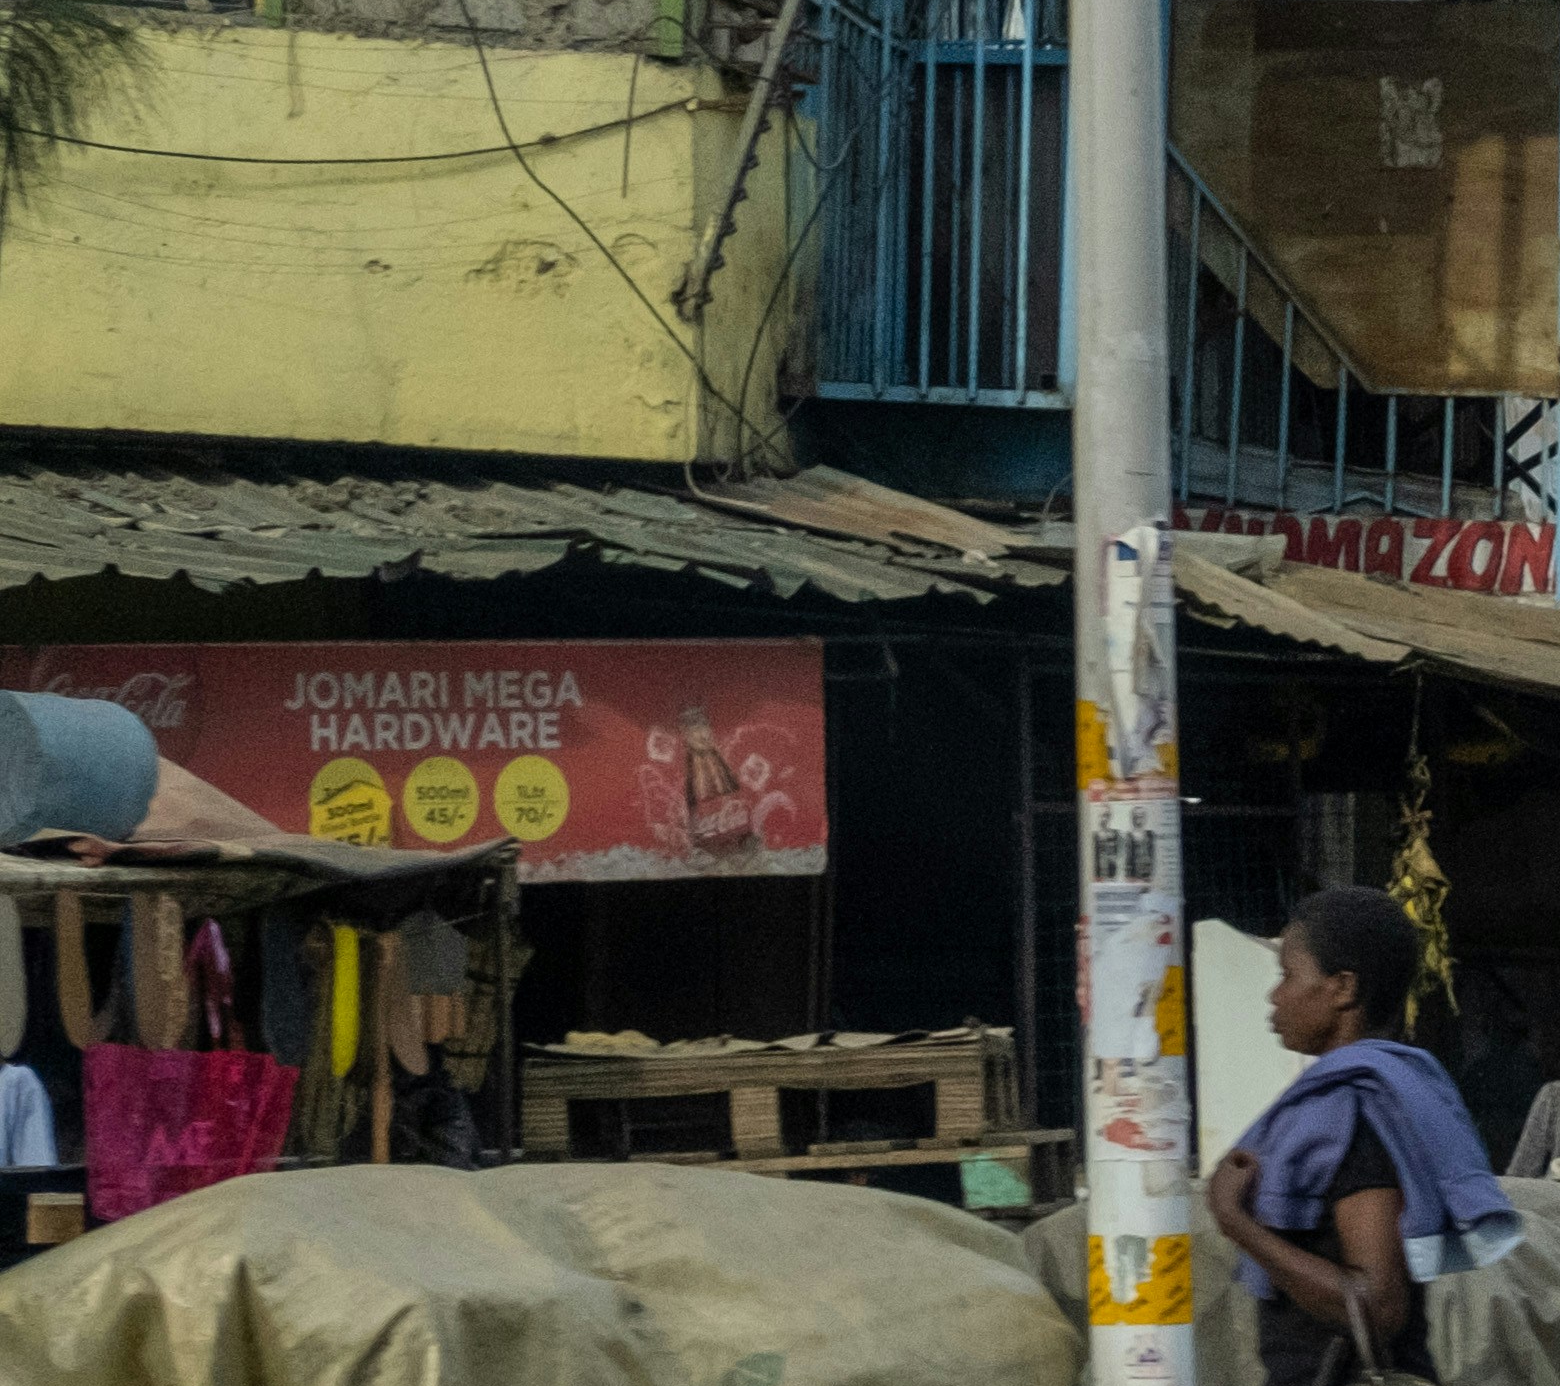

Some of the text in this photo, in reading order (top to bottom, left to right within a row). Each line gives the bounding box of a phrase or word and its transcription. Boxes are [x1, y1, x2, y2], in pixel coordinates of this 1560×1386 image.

[284, 670, 583, 709] JOMARI MEGA
[310, 712, 561, 751] HARDWARE
